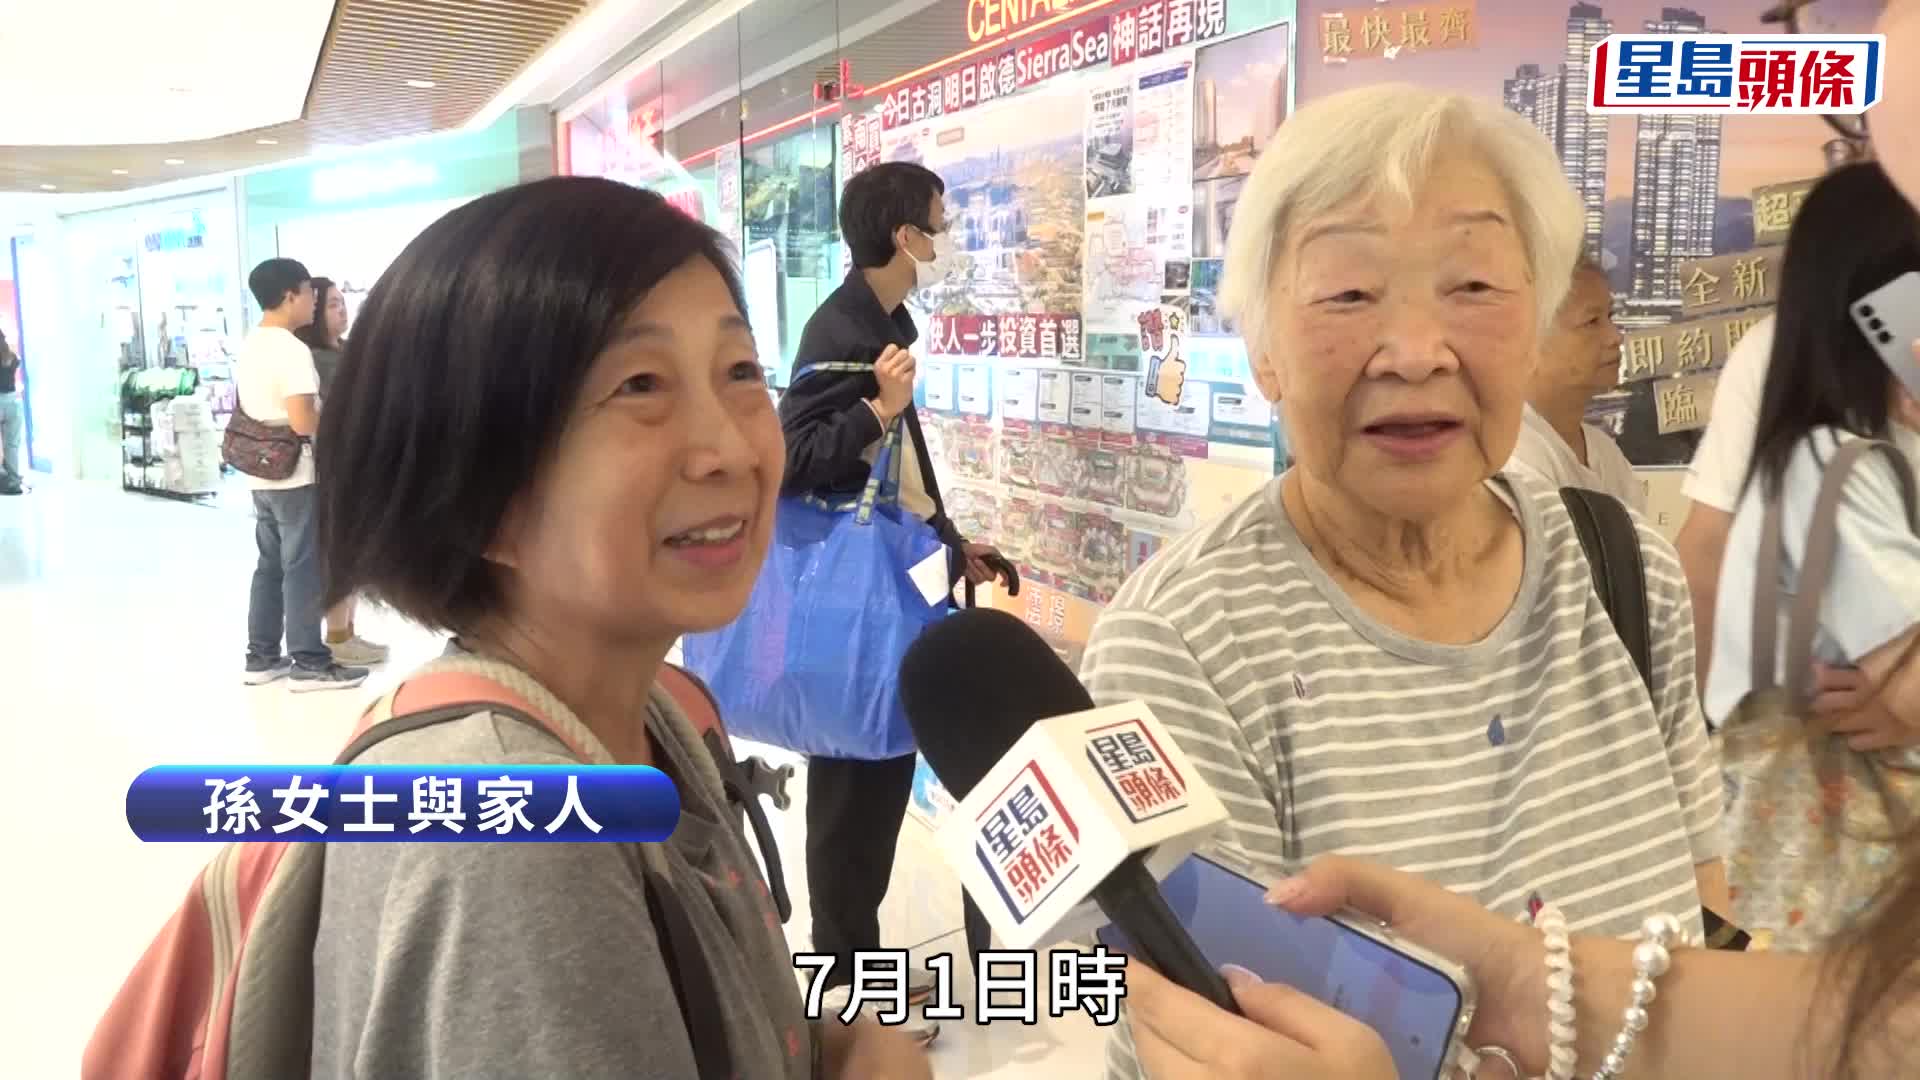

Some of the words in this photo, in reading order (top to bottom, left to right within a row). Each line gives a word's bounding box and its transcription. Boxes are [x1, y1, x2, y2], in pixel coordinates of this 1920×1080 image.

[1324, 9, 1470, 56] 最快最齊
[1757, 189, 1807, 233] 超
[930, 317, 1079, 358] 快人一步投資首選
[1091, 731, 1156, 773] 星島
[1117, 766, 1180, 812] 頭條
[981, 783, 1049, 864] 星島
[1004, 824, 1073, 904] 頭條
